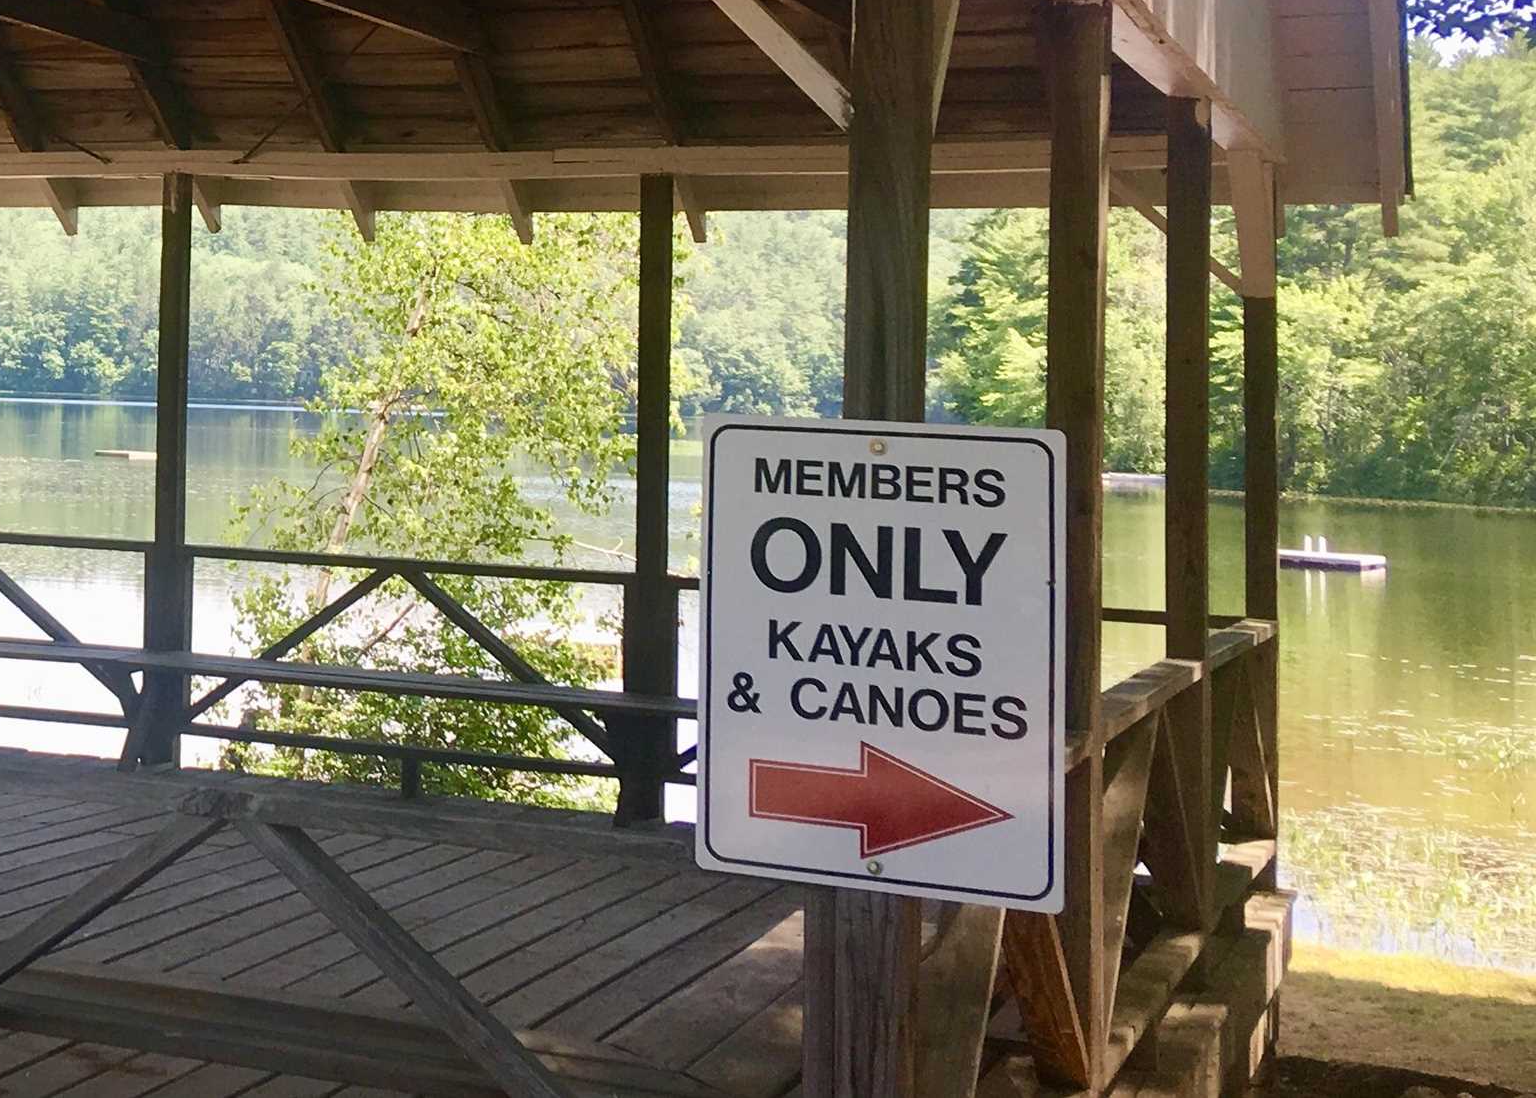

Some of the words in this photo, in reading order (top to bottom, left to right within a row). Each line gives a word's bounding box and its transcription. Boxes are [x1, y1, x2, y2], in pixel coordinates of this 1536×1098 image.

[754, 457, 1006, 508] MEMBERS
[750, 517, 1008, 606] ONLY
[768, 619, 982, 678] KAYAKS
[727, 671, 762, 715] &
[790, 677, 1028, 741] CANOES
